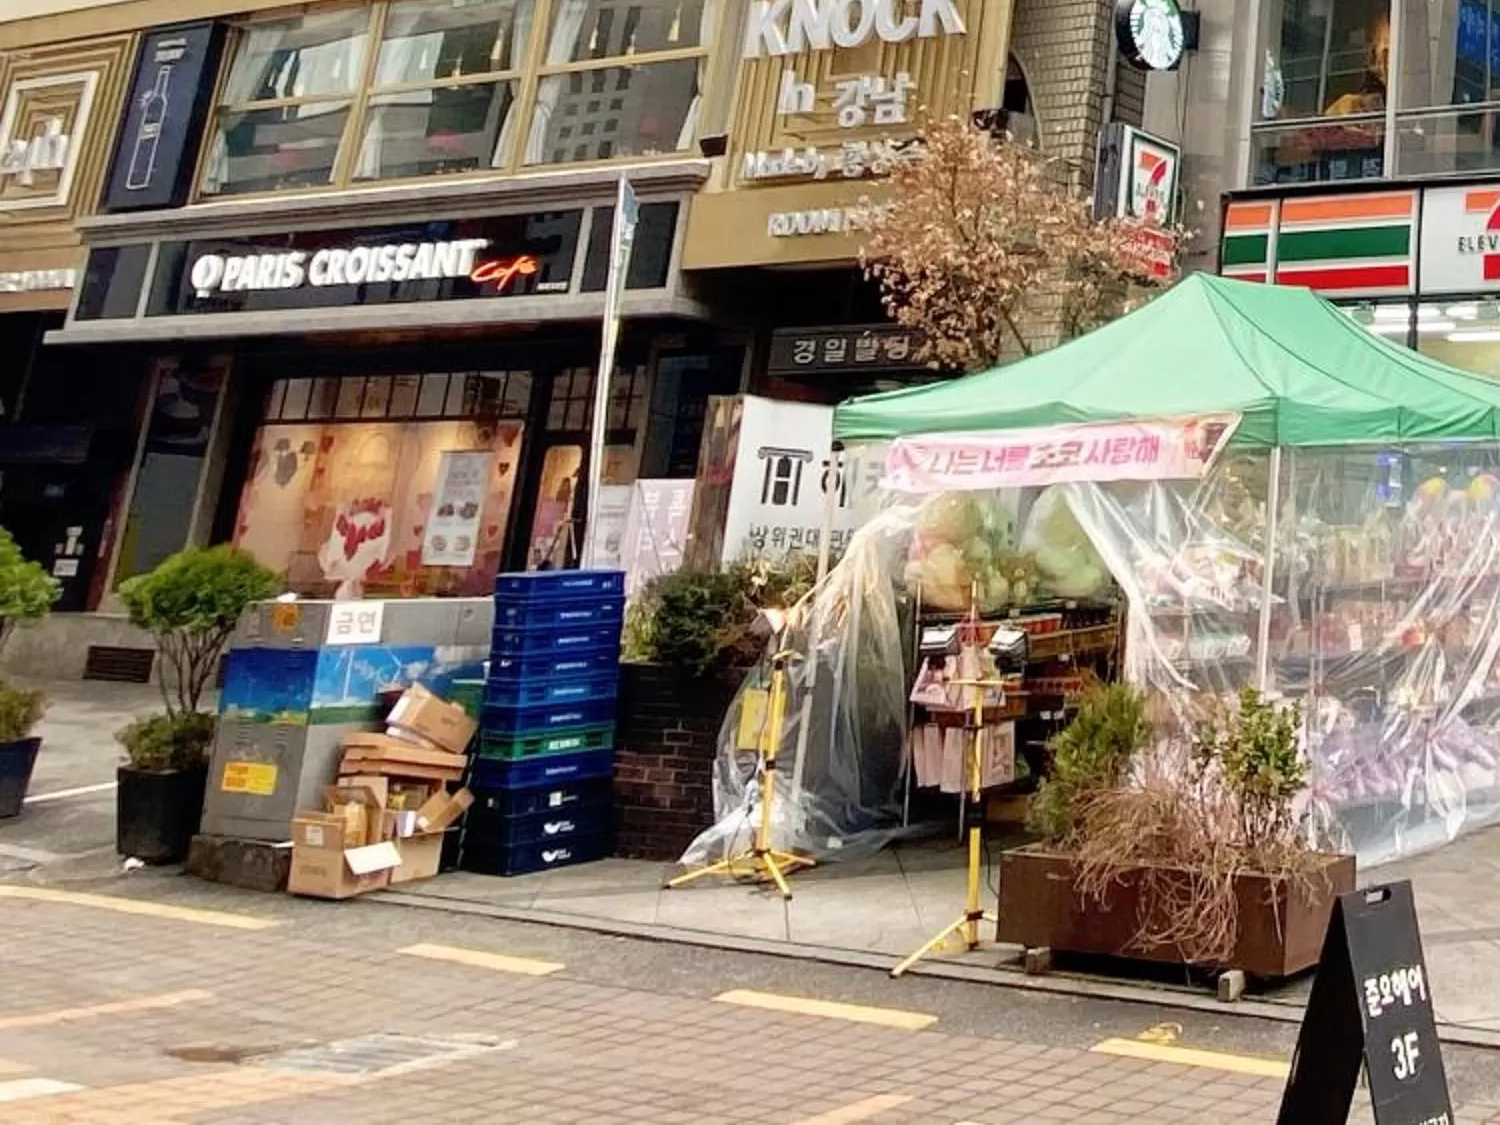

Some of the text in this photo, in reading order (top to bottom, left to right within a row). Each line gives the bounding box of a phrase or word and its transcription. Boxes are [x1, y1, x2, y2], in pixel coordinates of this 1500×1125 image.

[833, 71, 916, 128] 강남
[223, 250, 304, 293] PARIS
[308, 237, 488, 286] CROISSANT
[332, 613, 378, 639] 금연
[1363, 964, 1427, 1018] 준오헤어
[1390, 1031, 1420, 1080] 3F
